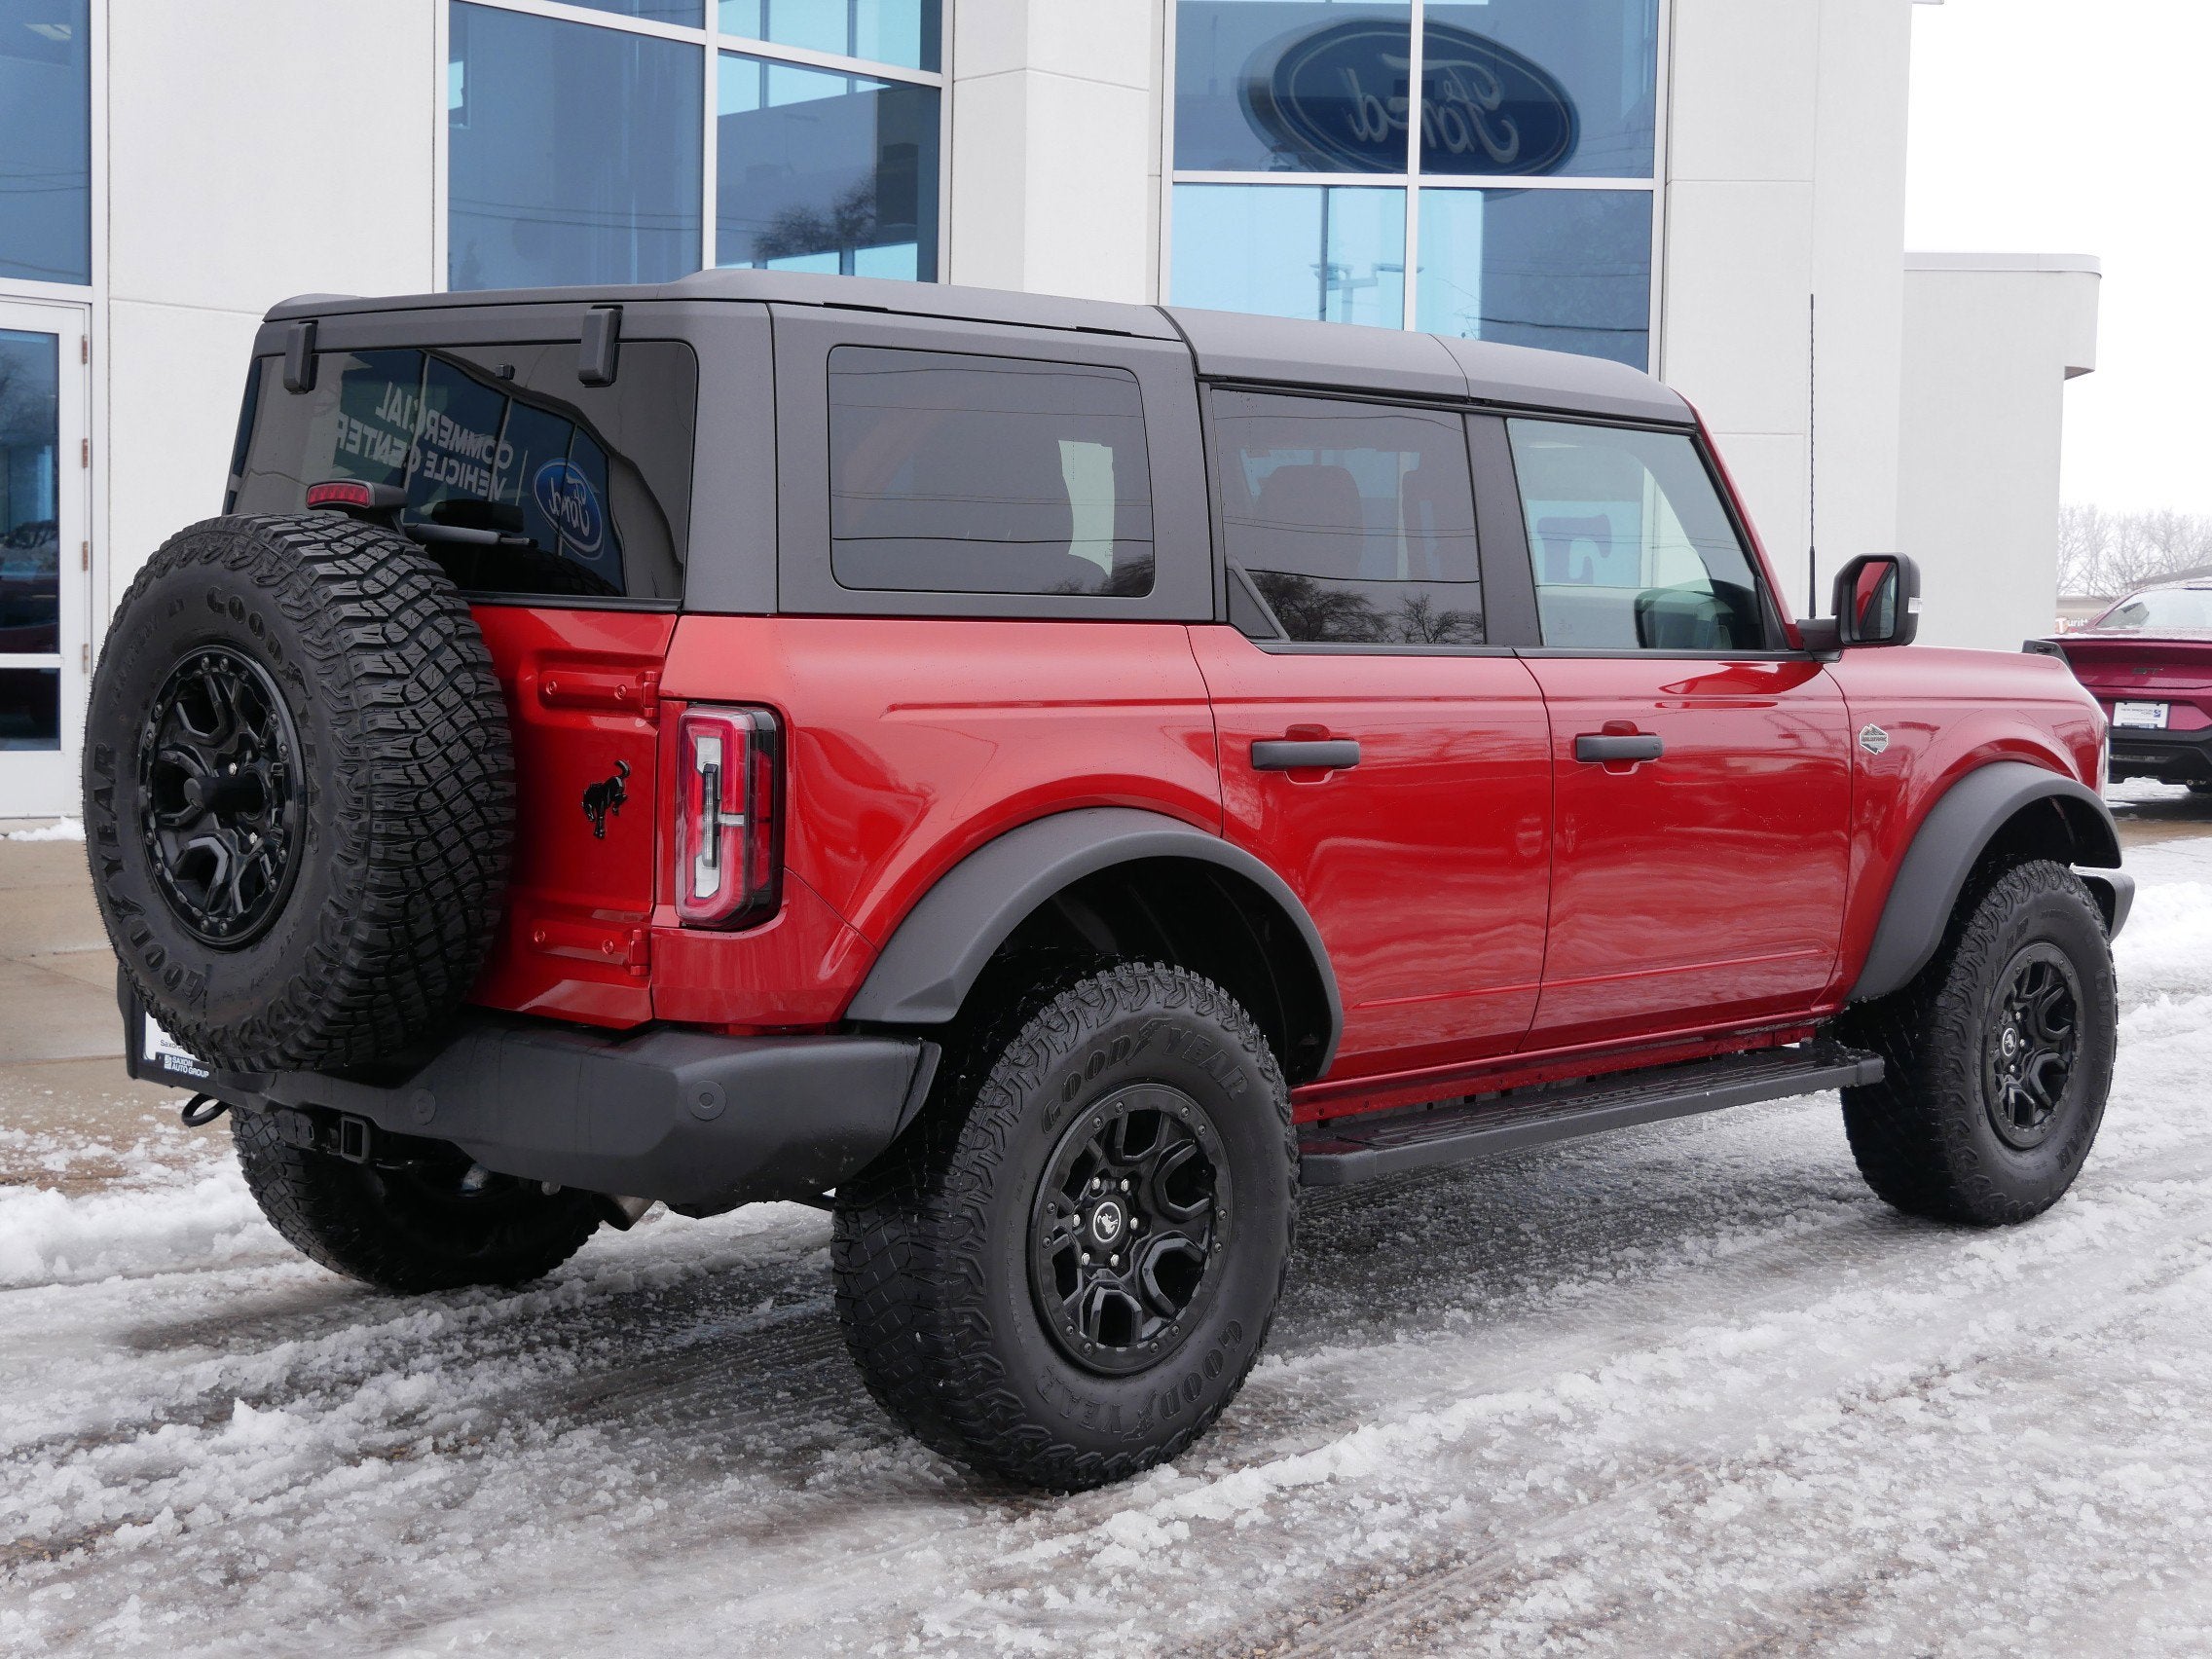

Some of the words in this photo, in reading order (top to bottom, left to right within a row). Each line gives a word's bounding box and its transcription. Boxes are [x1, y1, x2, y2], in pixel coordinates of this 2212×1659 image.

[172, 1056, 193, 1066] SAXON
[172, 1063, 188, 1073] AUTO
[189, 1067, 209, 1078] GROUP
[1041, 1017, 1250, 1134] GOODYEAR
